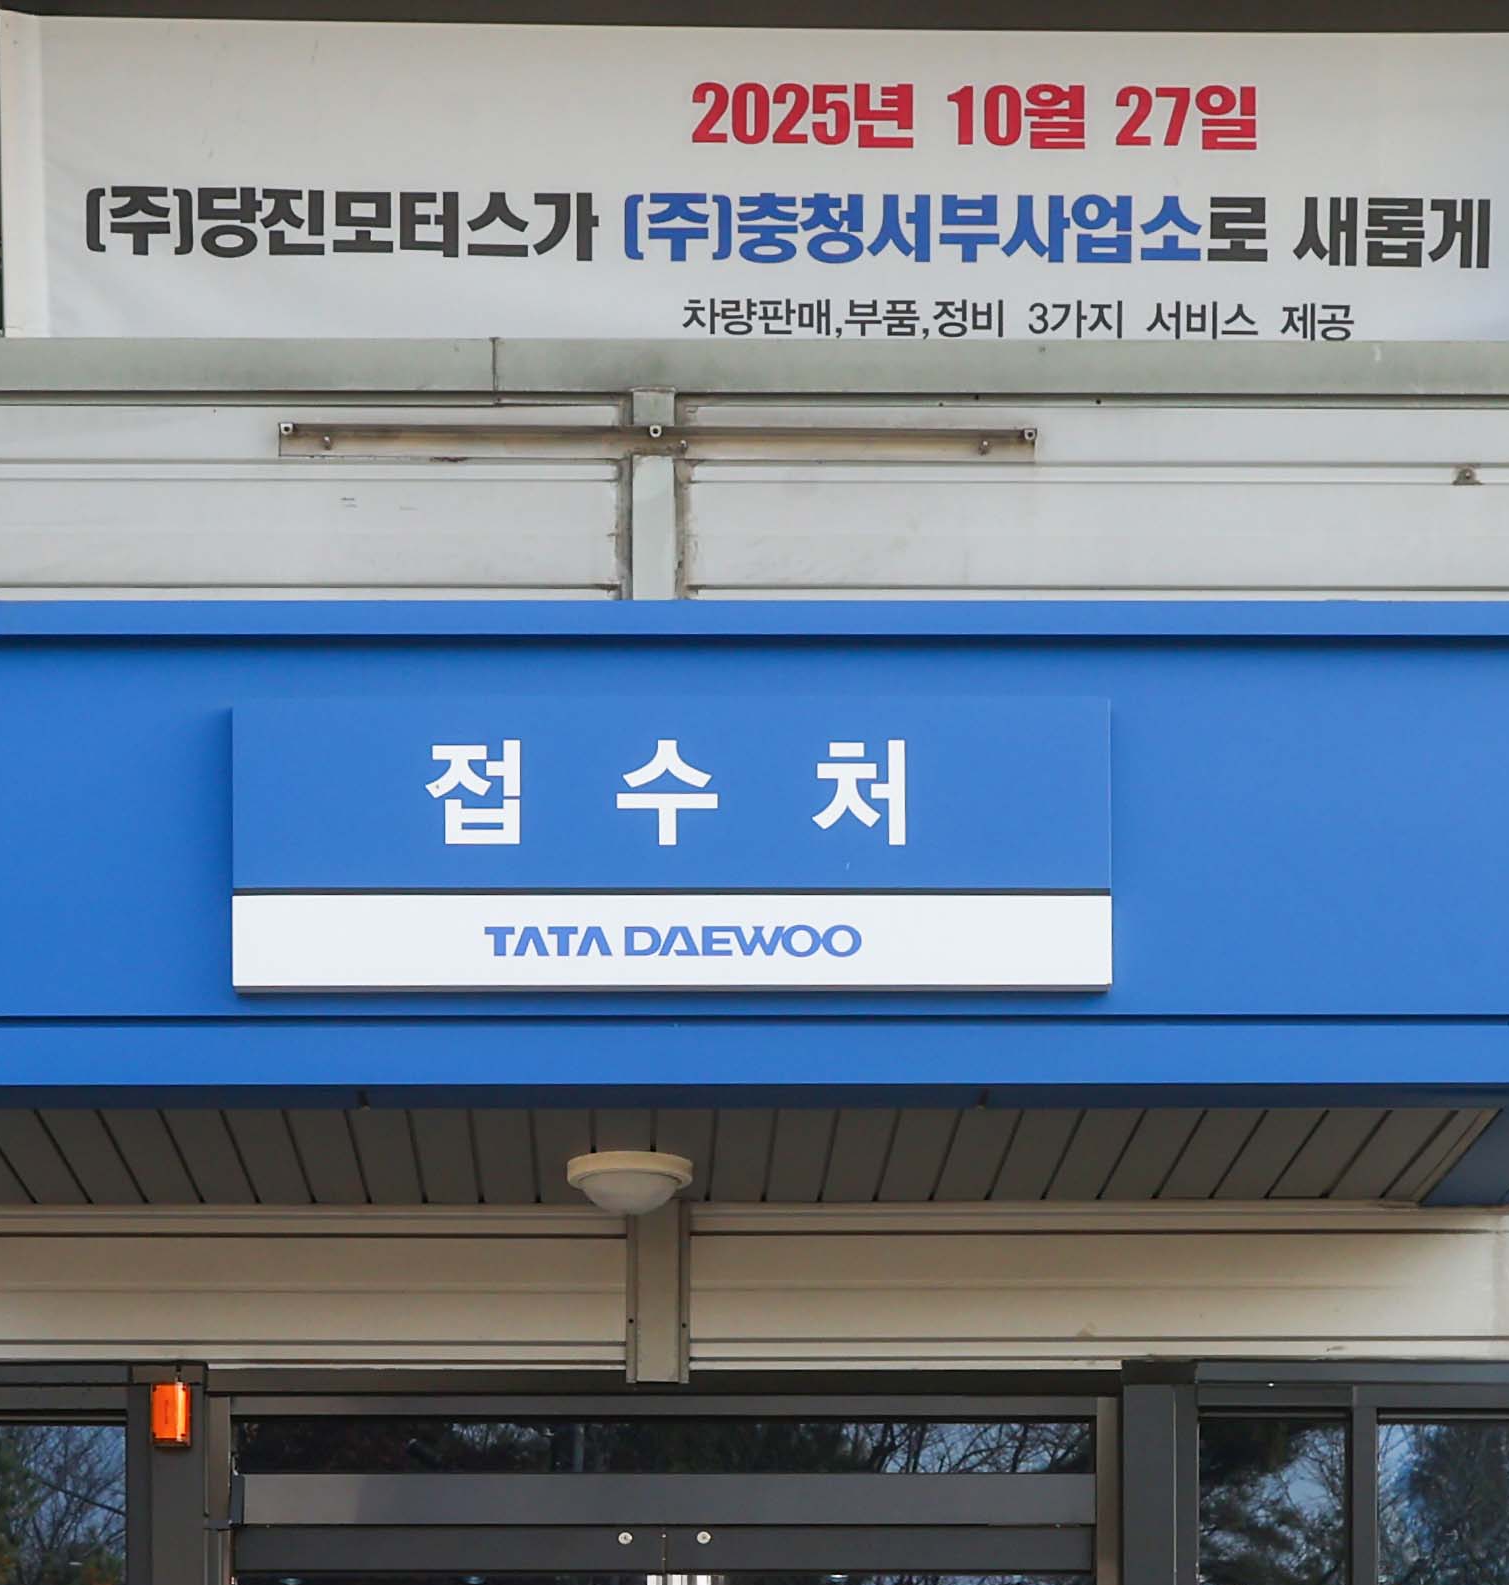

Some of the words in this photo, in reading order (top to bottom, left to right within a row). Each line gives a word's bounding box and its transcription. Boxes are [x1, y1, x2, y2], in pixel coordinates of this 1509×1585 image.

[691, 80, 914, 149] 2025년
[947, 82, 1087, 150] 10월
[1115, 84, 1258, 150] 27일
[85, 185, 599, 263] (주)당진모터스가
[623, 192, 1269, 264] (주)충청서부사업소로
[1293, 196, 1490, 269] 새롭게
[1028, 300, 1124, 339] 3가지
[1146, 300, 1258, 339] 서비스
[1280, 302, 1355, 342] 제공
[484, 924, 613, 958] TATA
[624, 924, 862, 958] DAEWOO
